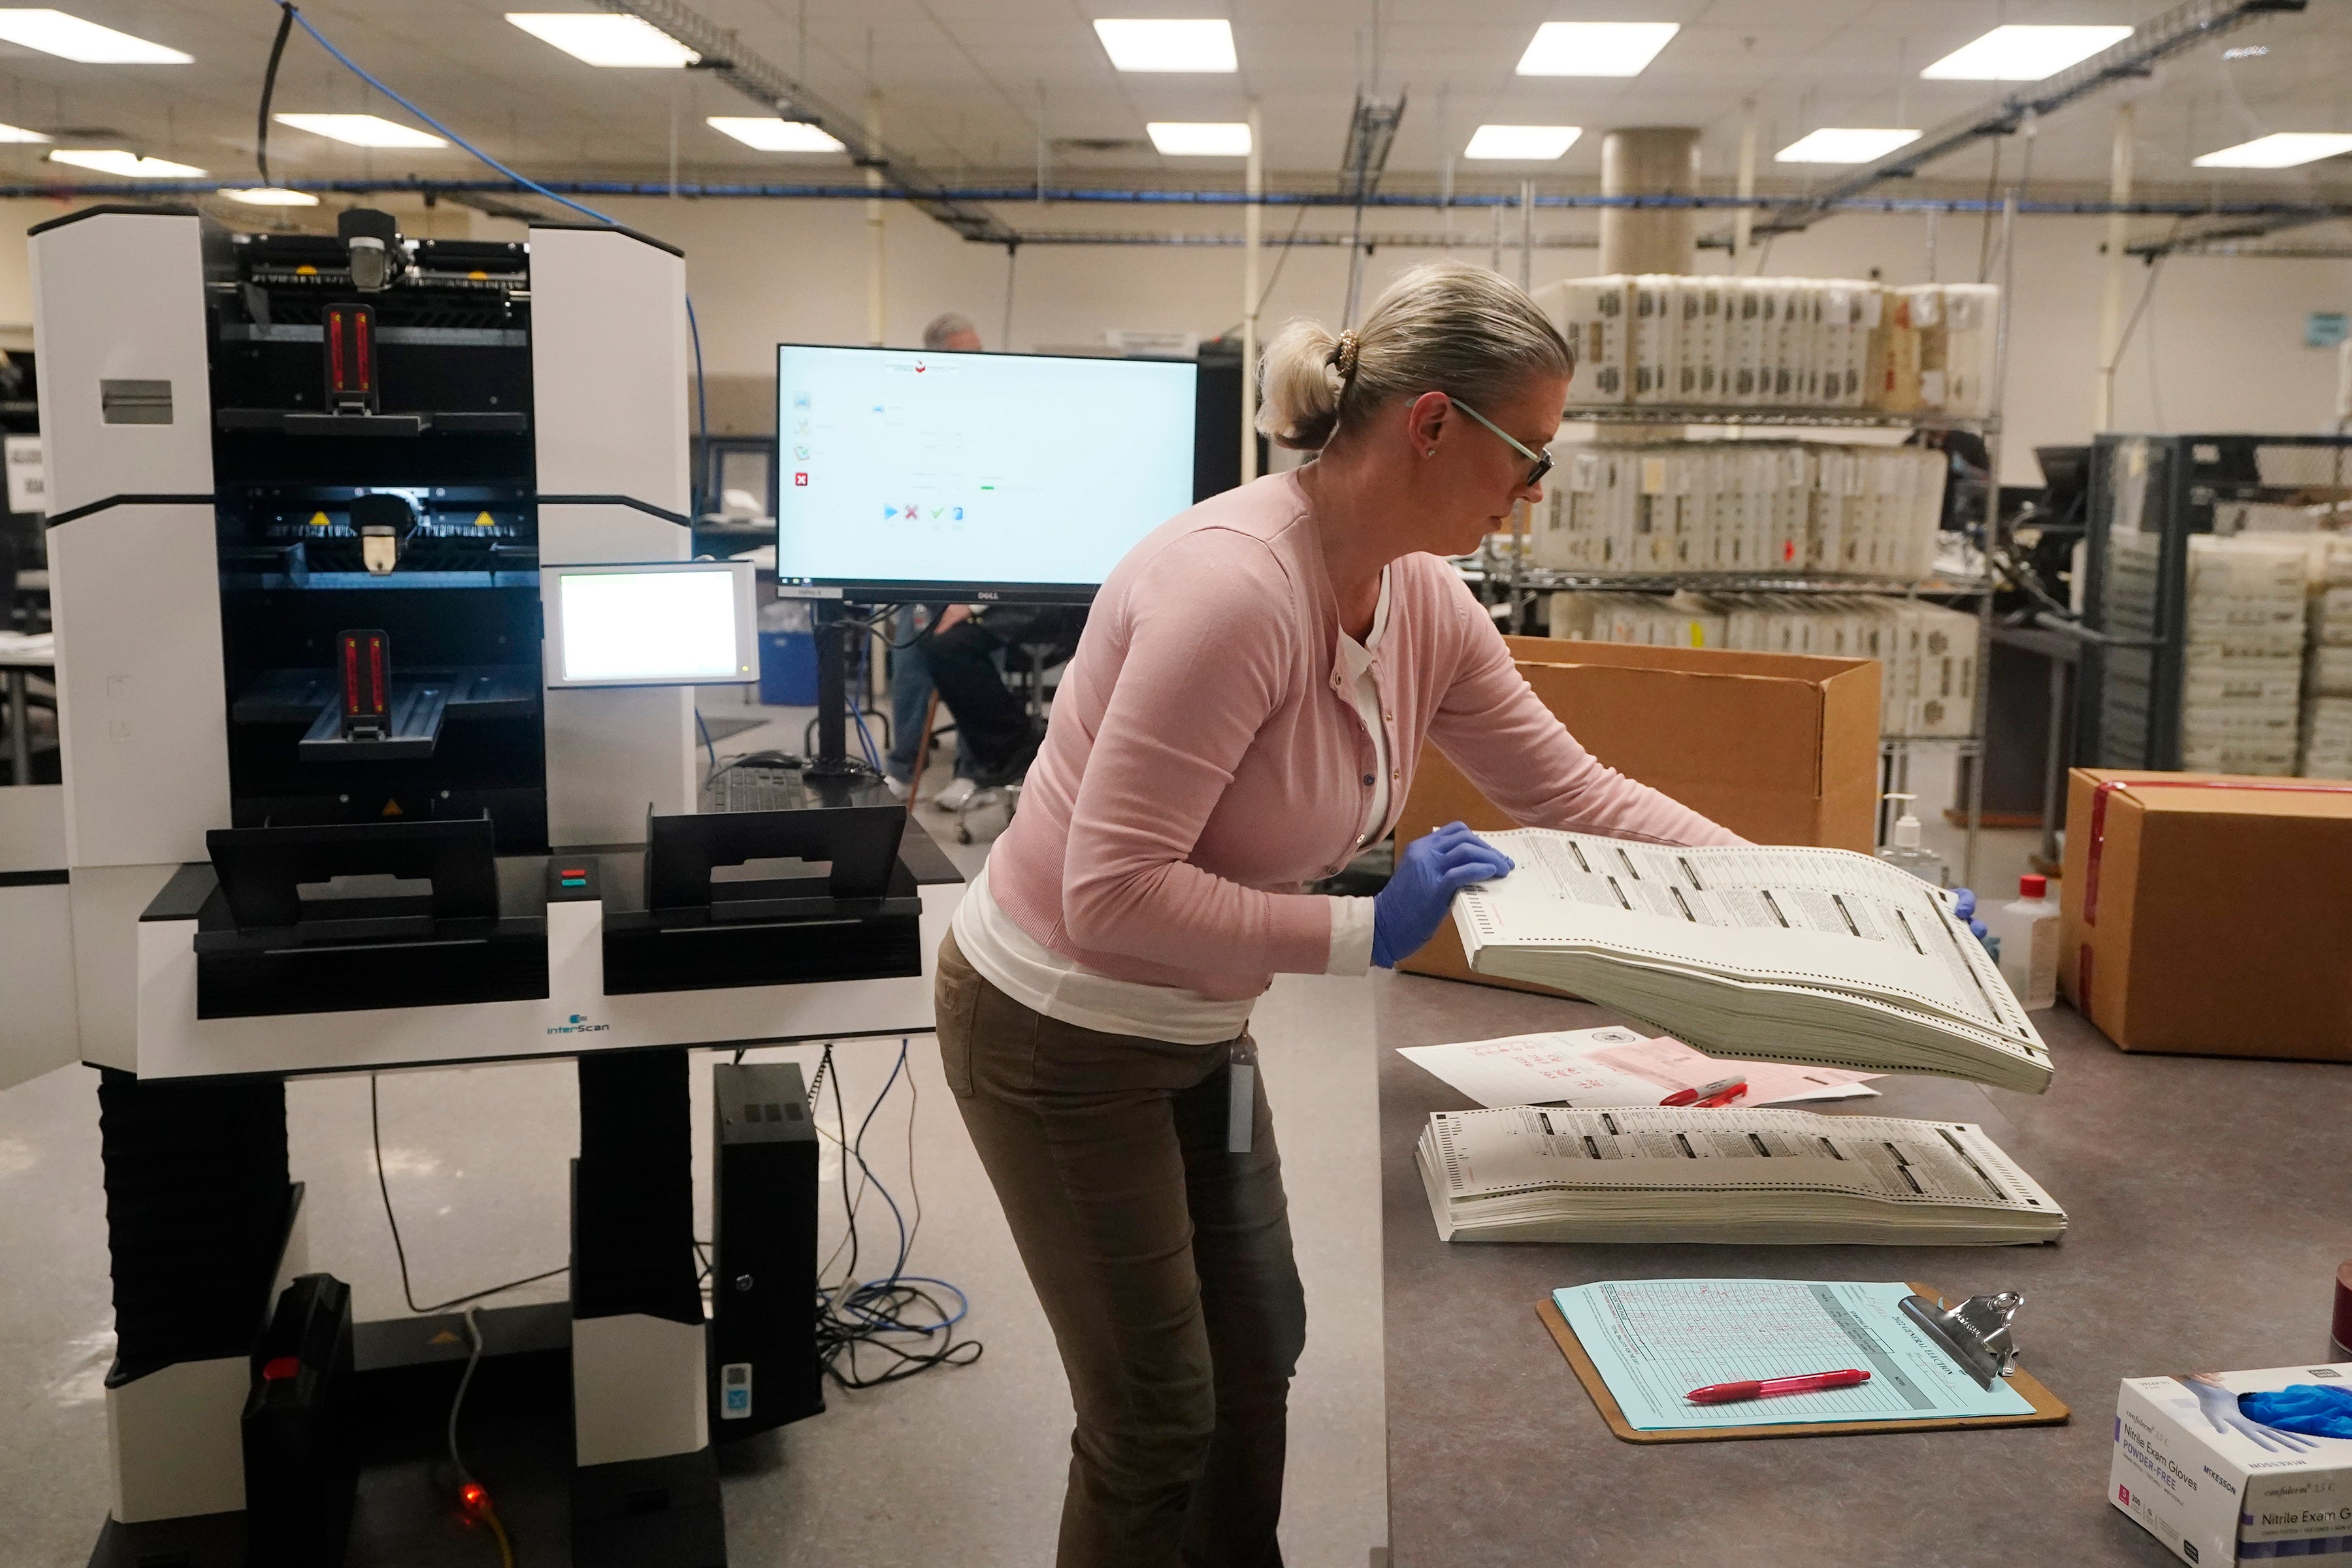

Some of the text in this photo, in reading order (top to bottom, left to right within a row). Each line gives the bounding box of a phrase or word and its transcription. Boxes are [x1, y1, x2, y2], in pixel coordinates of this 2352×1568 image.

[547, 1024, 610, 1034] interScan
[1902, 1326, 1927, 1348] GENERAL
[1924, 1350, 1955, 1375] ELECTION
[1895, 1376, 1906, 1386] NOTES
[2123, 1439, 2176, 1490] POWDER-FREE
[2124, 1423, 2145, 1448] Nitrile
[2146, 1441, 2166, 1467] Exam
[2169, 1460, 2198, 1491] Gloves
[2262, 1512, 2298, 1525] Nitrile
[2302, 1510, 2335, 1522] Exam
